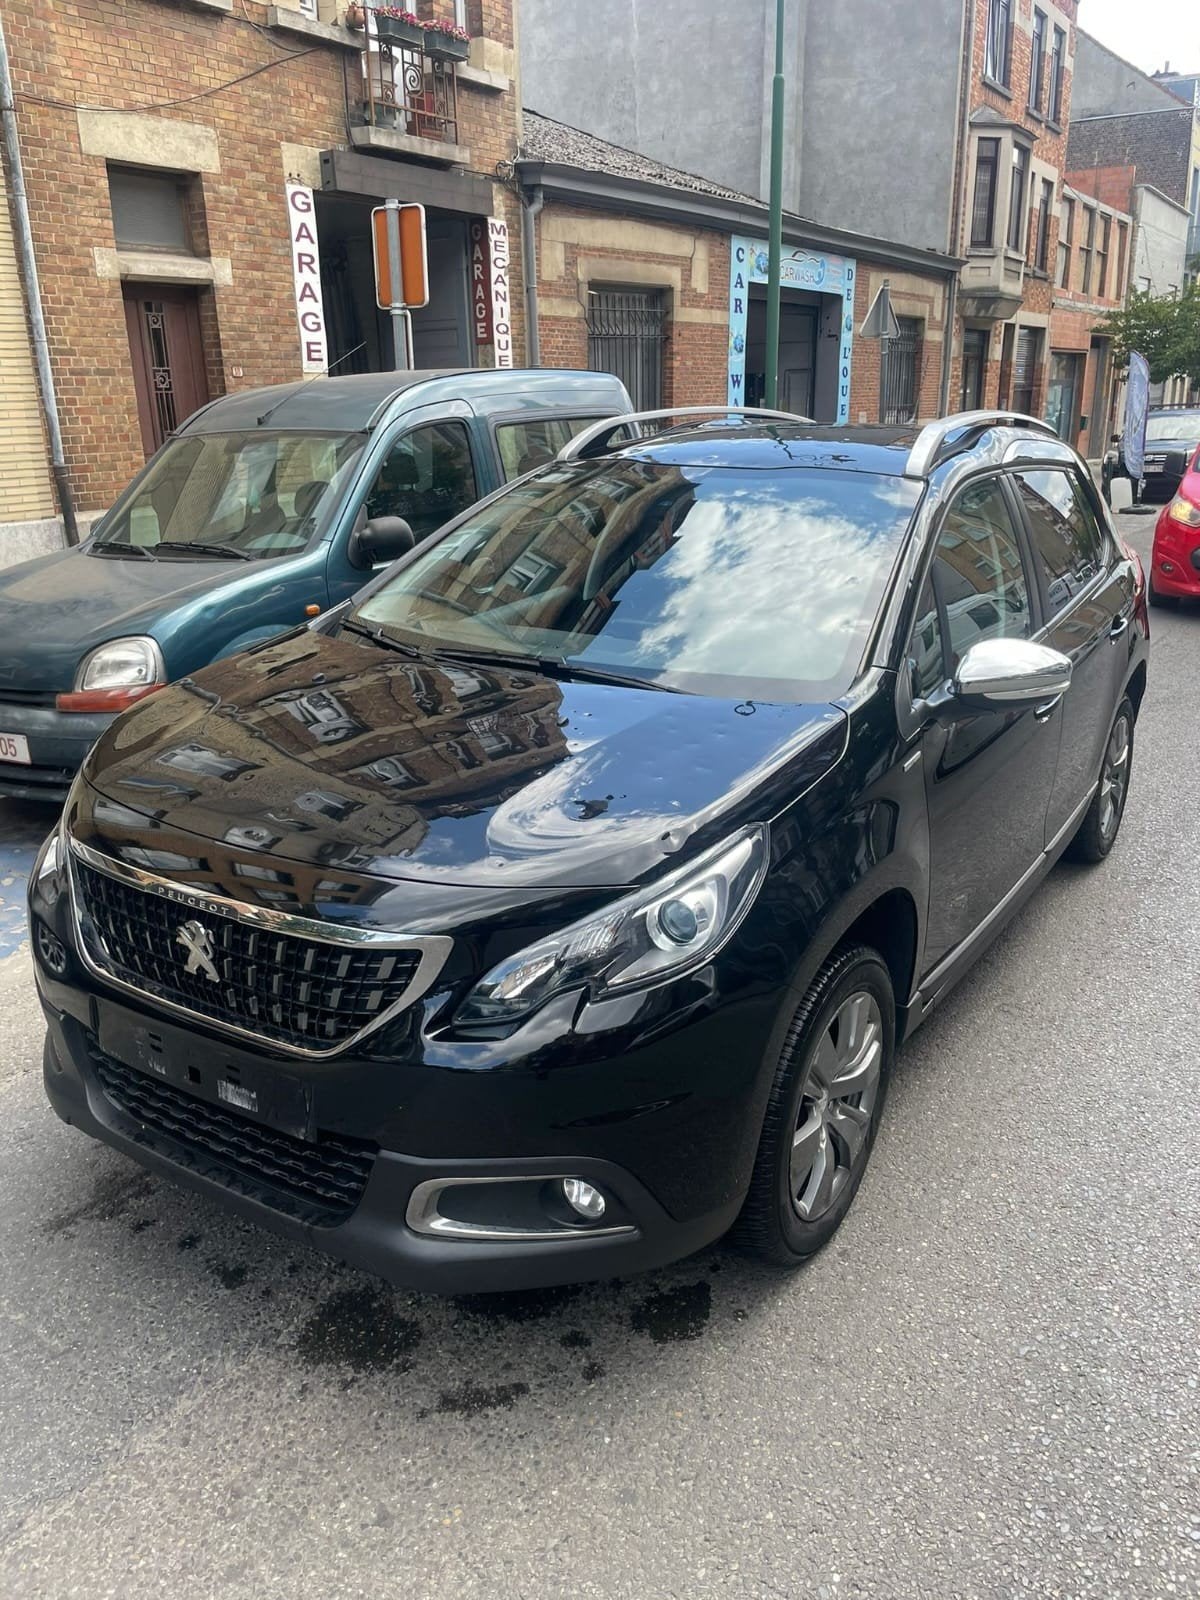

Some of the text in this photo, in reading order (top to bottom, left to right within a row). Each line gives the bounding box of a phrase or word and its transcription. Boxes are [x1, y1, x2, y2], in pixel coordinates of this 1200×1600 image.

[290, 190, 324, 362] GARAGE
[471, 223, 488, 338] GARAGE
[489, 222, 510, 367] MECANIQUE
[734, 247, 745, 314] CAR
[158, 887, 229, 915] PEUGEOT
